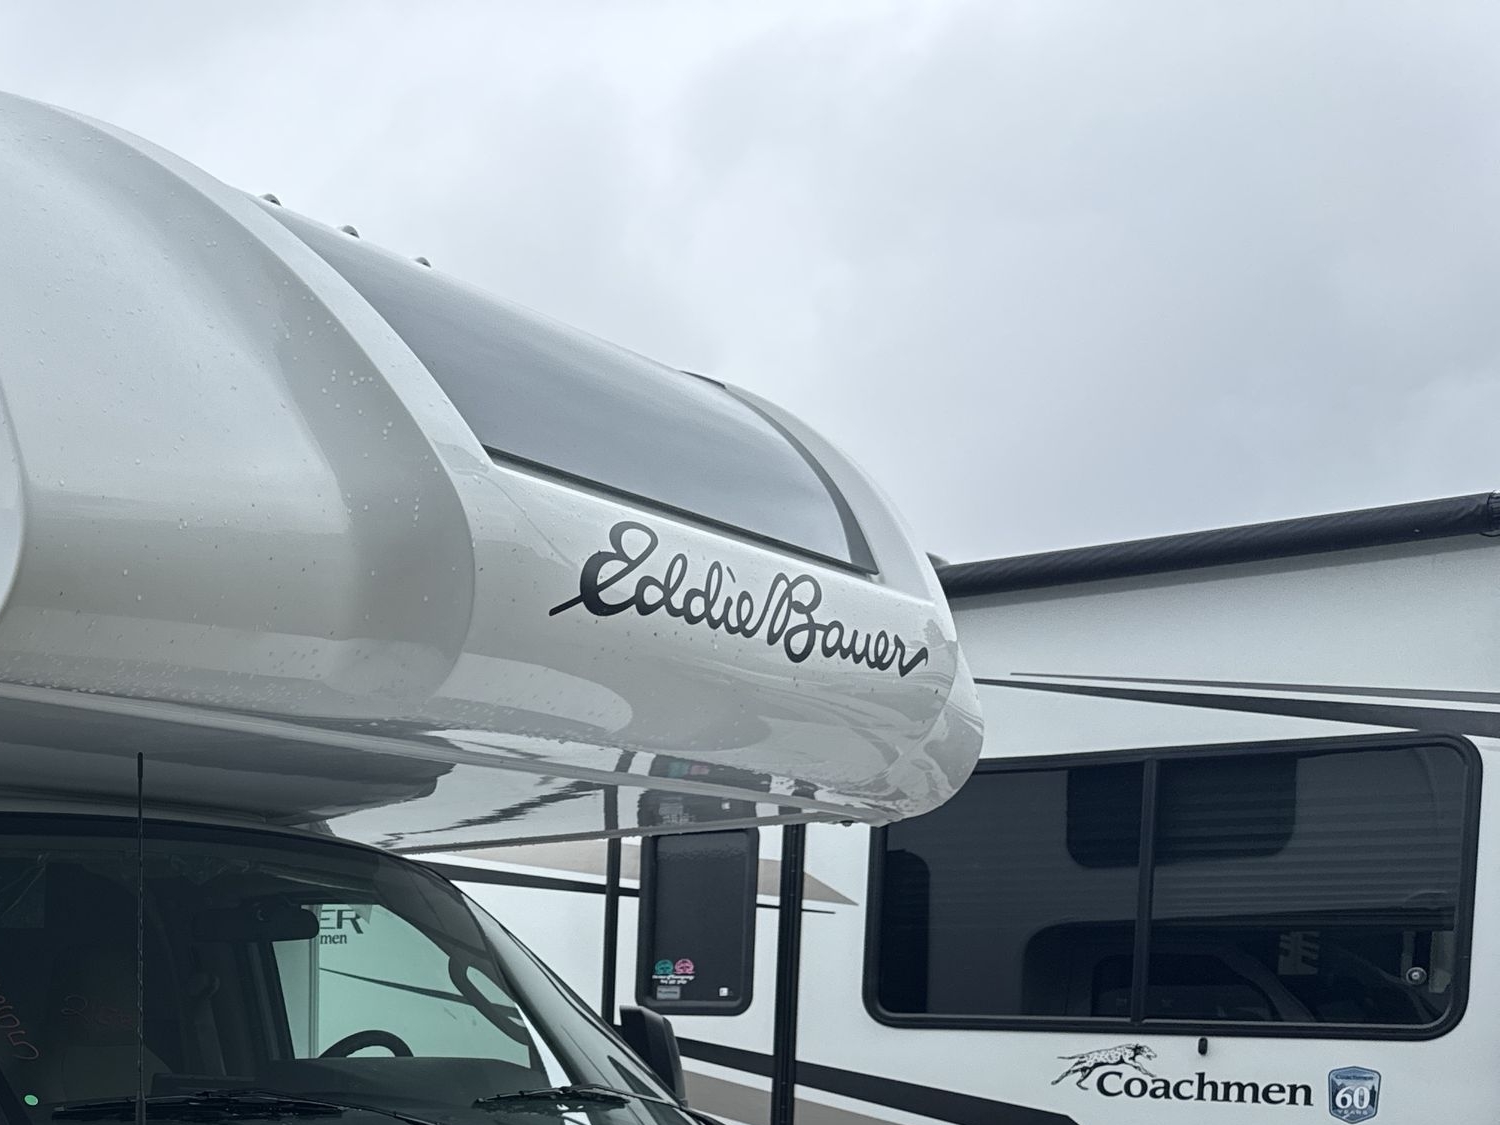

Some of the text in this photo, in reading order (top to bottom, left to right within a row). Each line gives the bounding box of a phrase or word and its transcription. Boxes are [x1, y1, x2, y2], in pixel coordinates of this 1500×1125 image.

[548, 520, 929, 678] Eddie Bauer
[1096, 1070, 1314, 1106] Coachmen
[1335, 1086, 1371, 1110] 60
